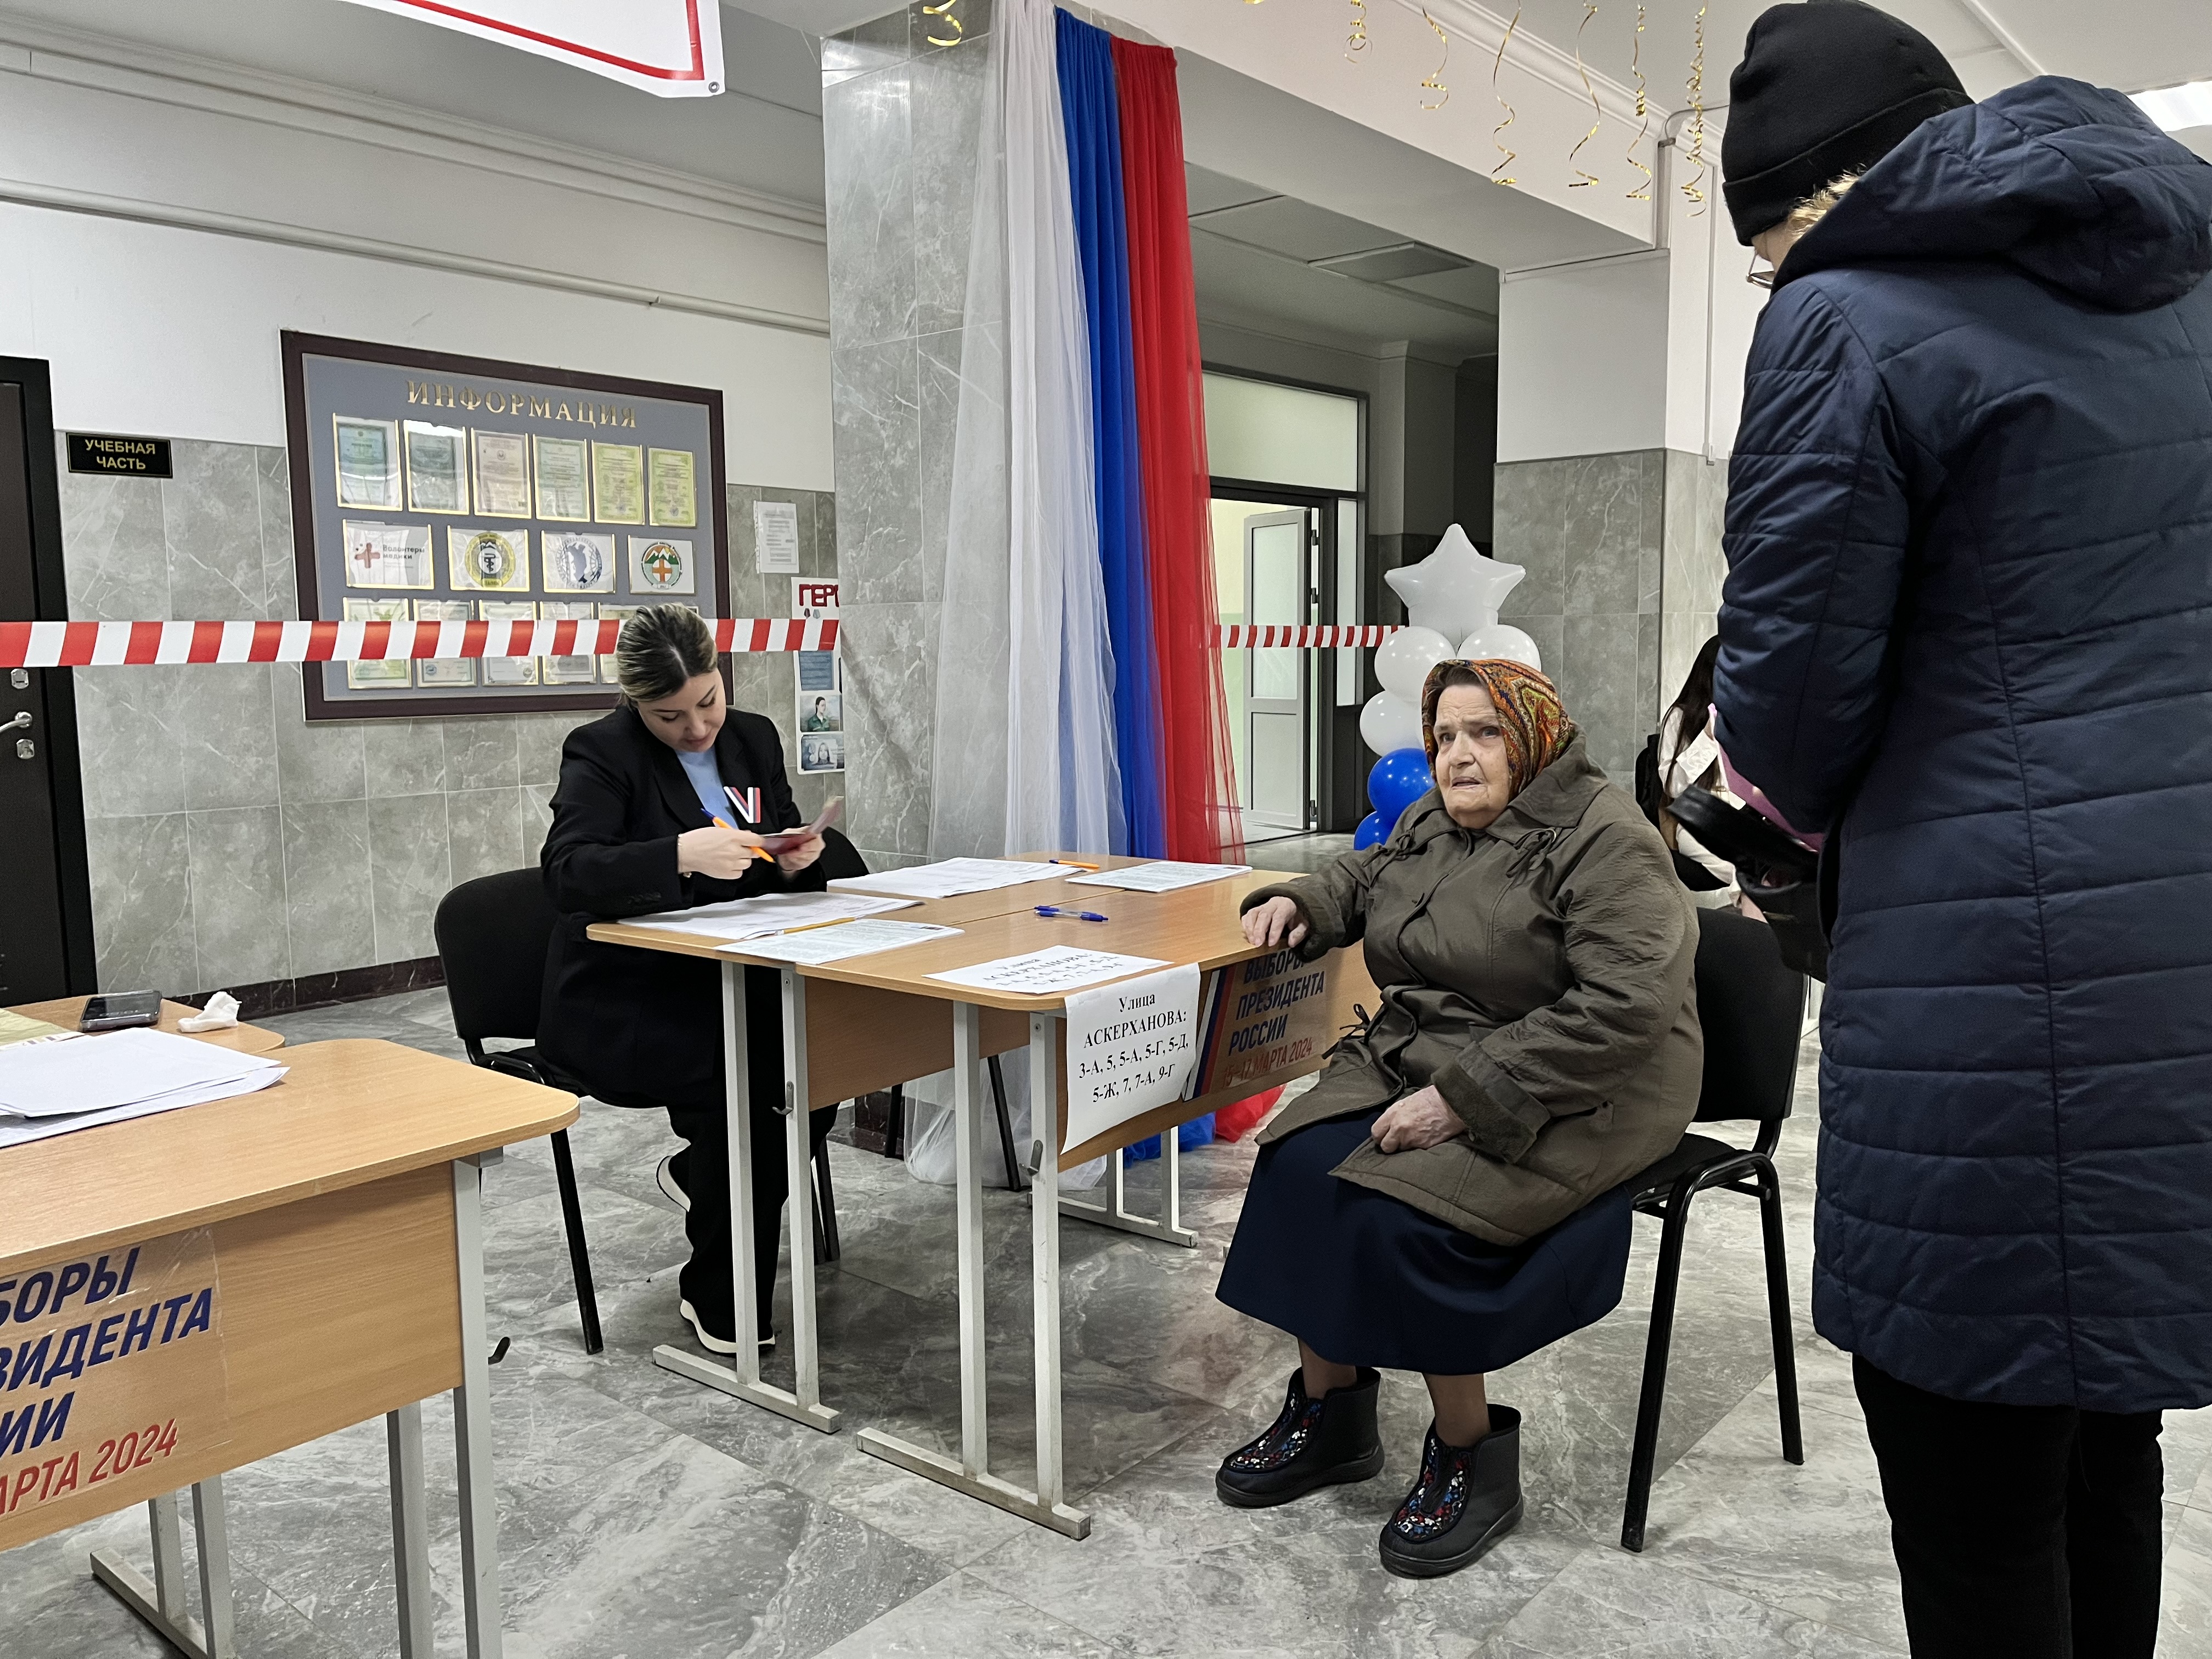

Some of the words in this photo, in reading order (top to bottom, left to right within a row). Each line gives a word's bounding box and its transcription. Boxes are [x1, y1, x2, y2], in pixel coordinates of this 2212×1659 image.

[405, 380, 637, 429] ИНФОРМАЦИЯ
[84, 439, 156, 454] УЧЕБНАЯ
[96, 456, 146, 470] ЧАСТЬ
[382, 544, 425, 555] Волонтеры
[724, 786, 761, 823] V
[1118, 994, 1155, 1012] Улица
[1235, 970, 1325, 1021] ПРЕЗИДЕНТА
[1084, 1009, 1187, 1048] АСКЕРХАНОВА:
[1228, 1013, 1289, 1057] РОССИИ
[1079, 1059, 1103, 1079] 3-А,
[1107, 1054, 1116, 1071] 5,
[1119, 1048, 1142, 1066] 5-А,
[1145, 1040, 1165, 1059] 5-Г,
[1169, 1033, 1188, 1052] 5-Д,
[1252, 1045, 1288, 1077] МАРТА
[1290, 1036, 1313, 1062] 2024
[1093, 1081, 1119, 1103] 5-Ж,
[1123, 1077, 1131, 1094] 7,
[1135, 1070, 1155, 1088] 7-А,
[1158, 1063, 1176, 1081] 9-Г
[88, 1418, 177, 1483] 2024
